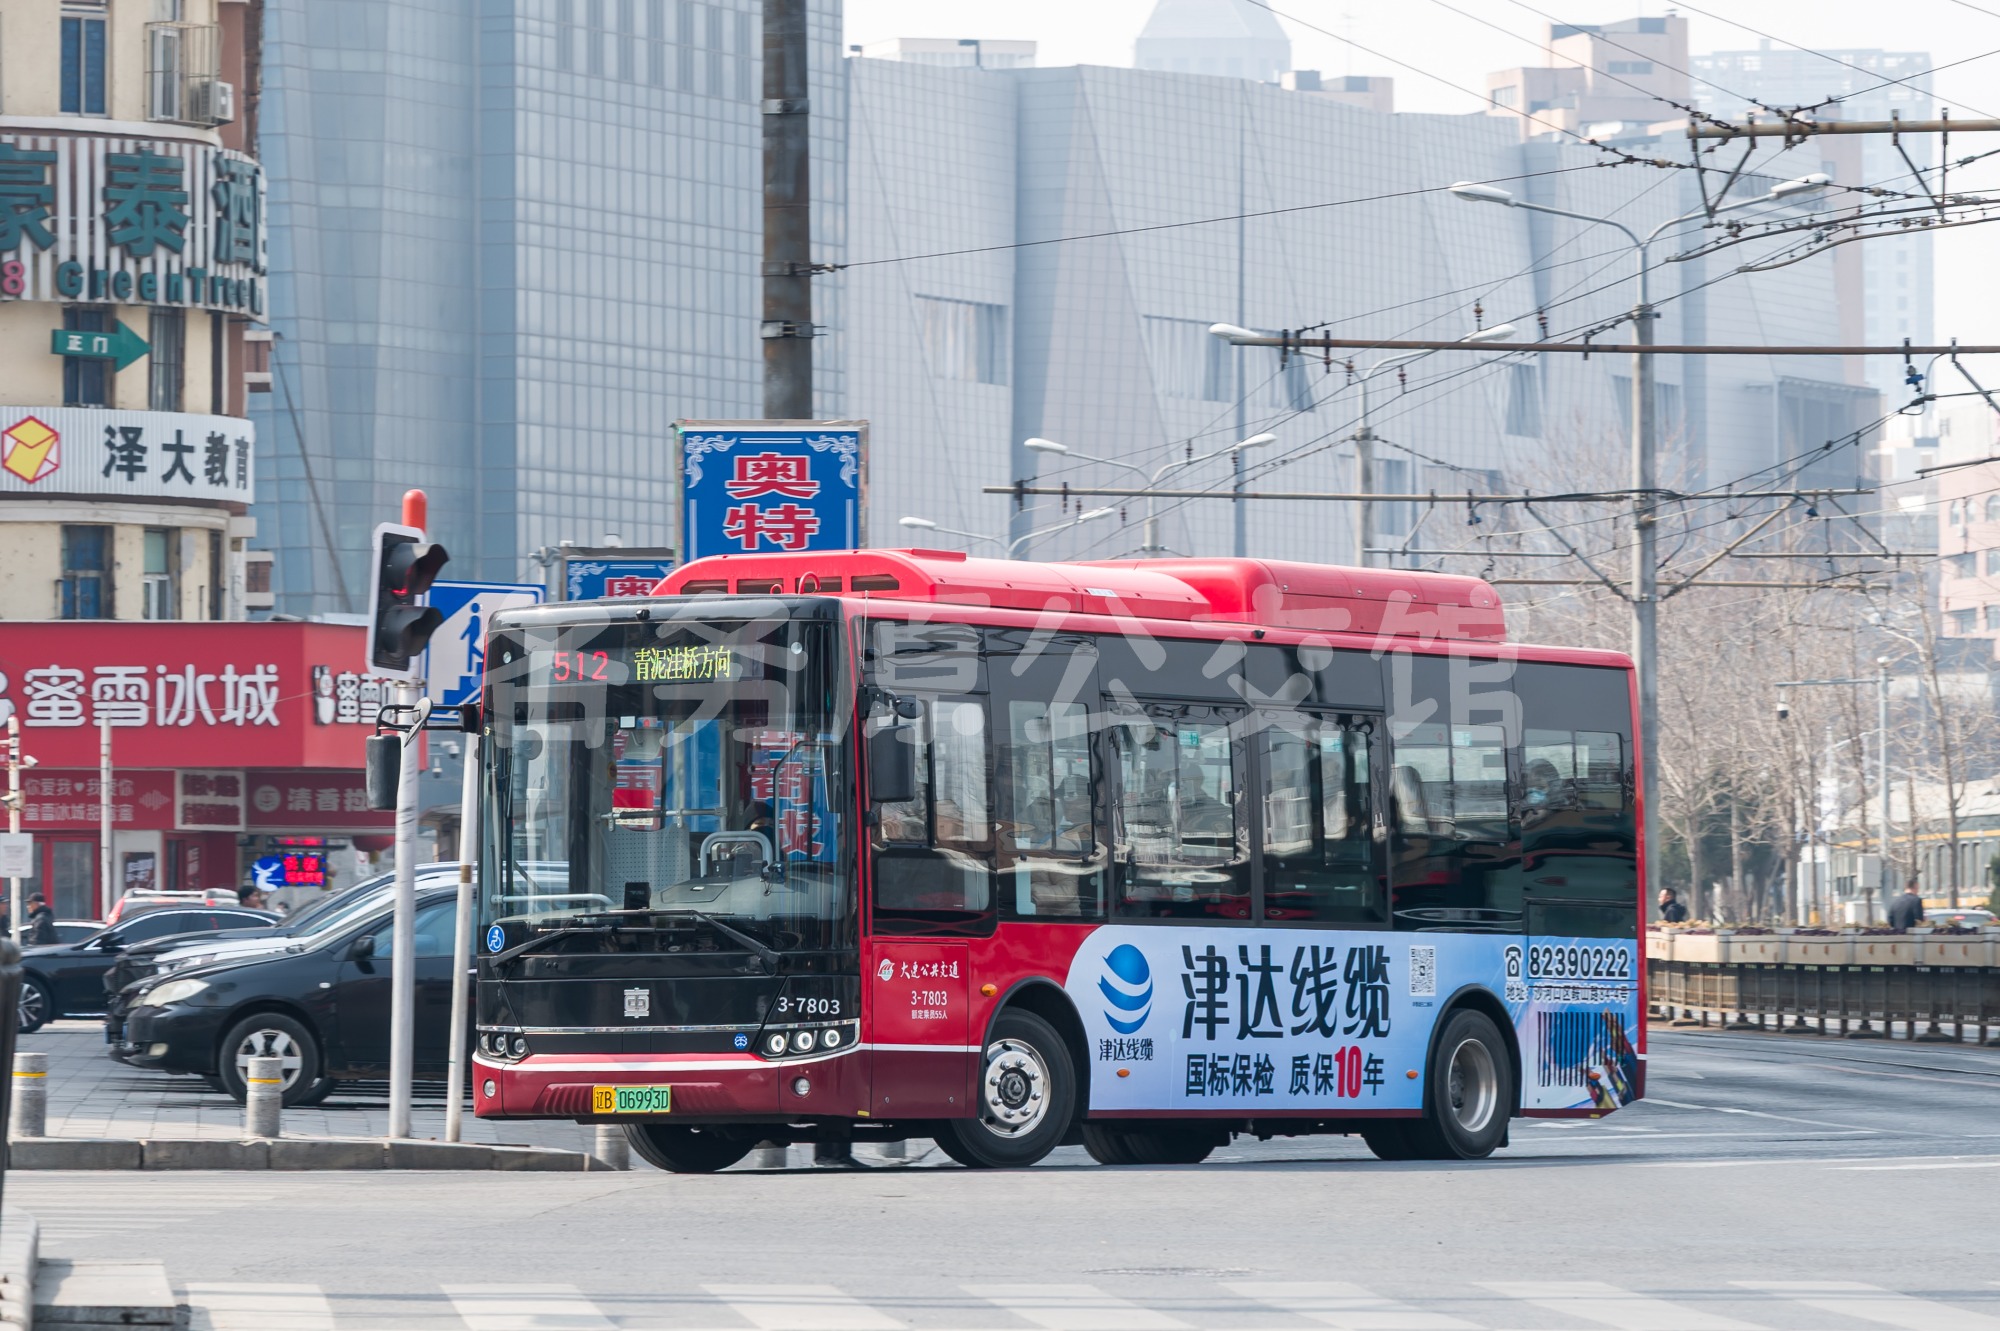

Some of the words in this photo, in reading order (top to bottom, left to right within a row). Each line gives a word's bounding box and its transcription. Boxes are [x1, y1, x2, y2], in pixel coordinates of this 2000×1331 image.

[66, 334, 109, 354] 正门
[102, 424, 250, 490] 泽大教育
[722, 451, 821, 551] 奥特
[554, 650, 609, 681] 512
[634, 644, 732, 681] 青泥洼桥方向
[22, 664, 281, 728] 蜜雪冰城
[1528, 945, 1630, 979] 82390222
[777, 997, 841, 1016] 3-7803
[910, 990, 948, 1006] 3-7803
[1181, 944, 1392, 1041] 津达线缆
[1098, 1038, 1154, 1062] 津达线缆
[1186, 1052, 1275, 1098] 国标保检
[1288, 1045, 1385, 1099] 质保10年
